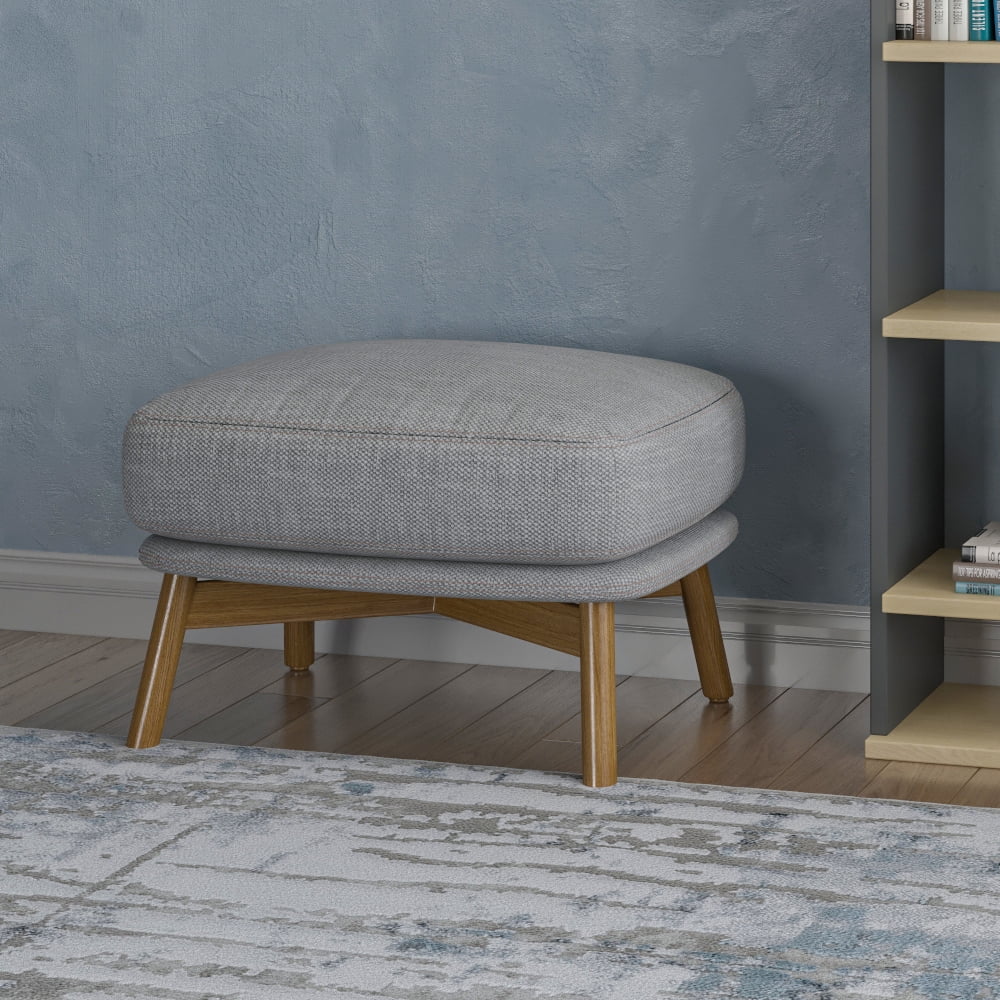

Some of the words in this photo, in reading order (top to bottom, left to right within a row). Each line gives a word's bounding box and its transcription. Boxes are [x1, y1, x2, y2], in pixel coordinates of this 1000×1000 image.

[896, 2, 910, 10] La
[972, 10, 985, 30] SILENT
[988, 546, 995, 561] La
